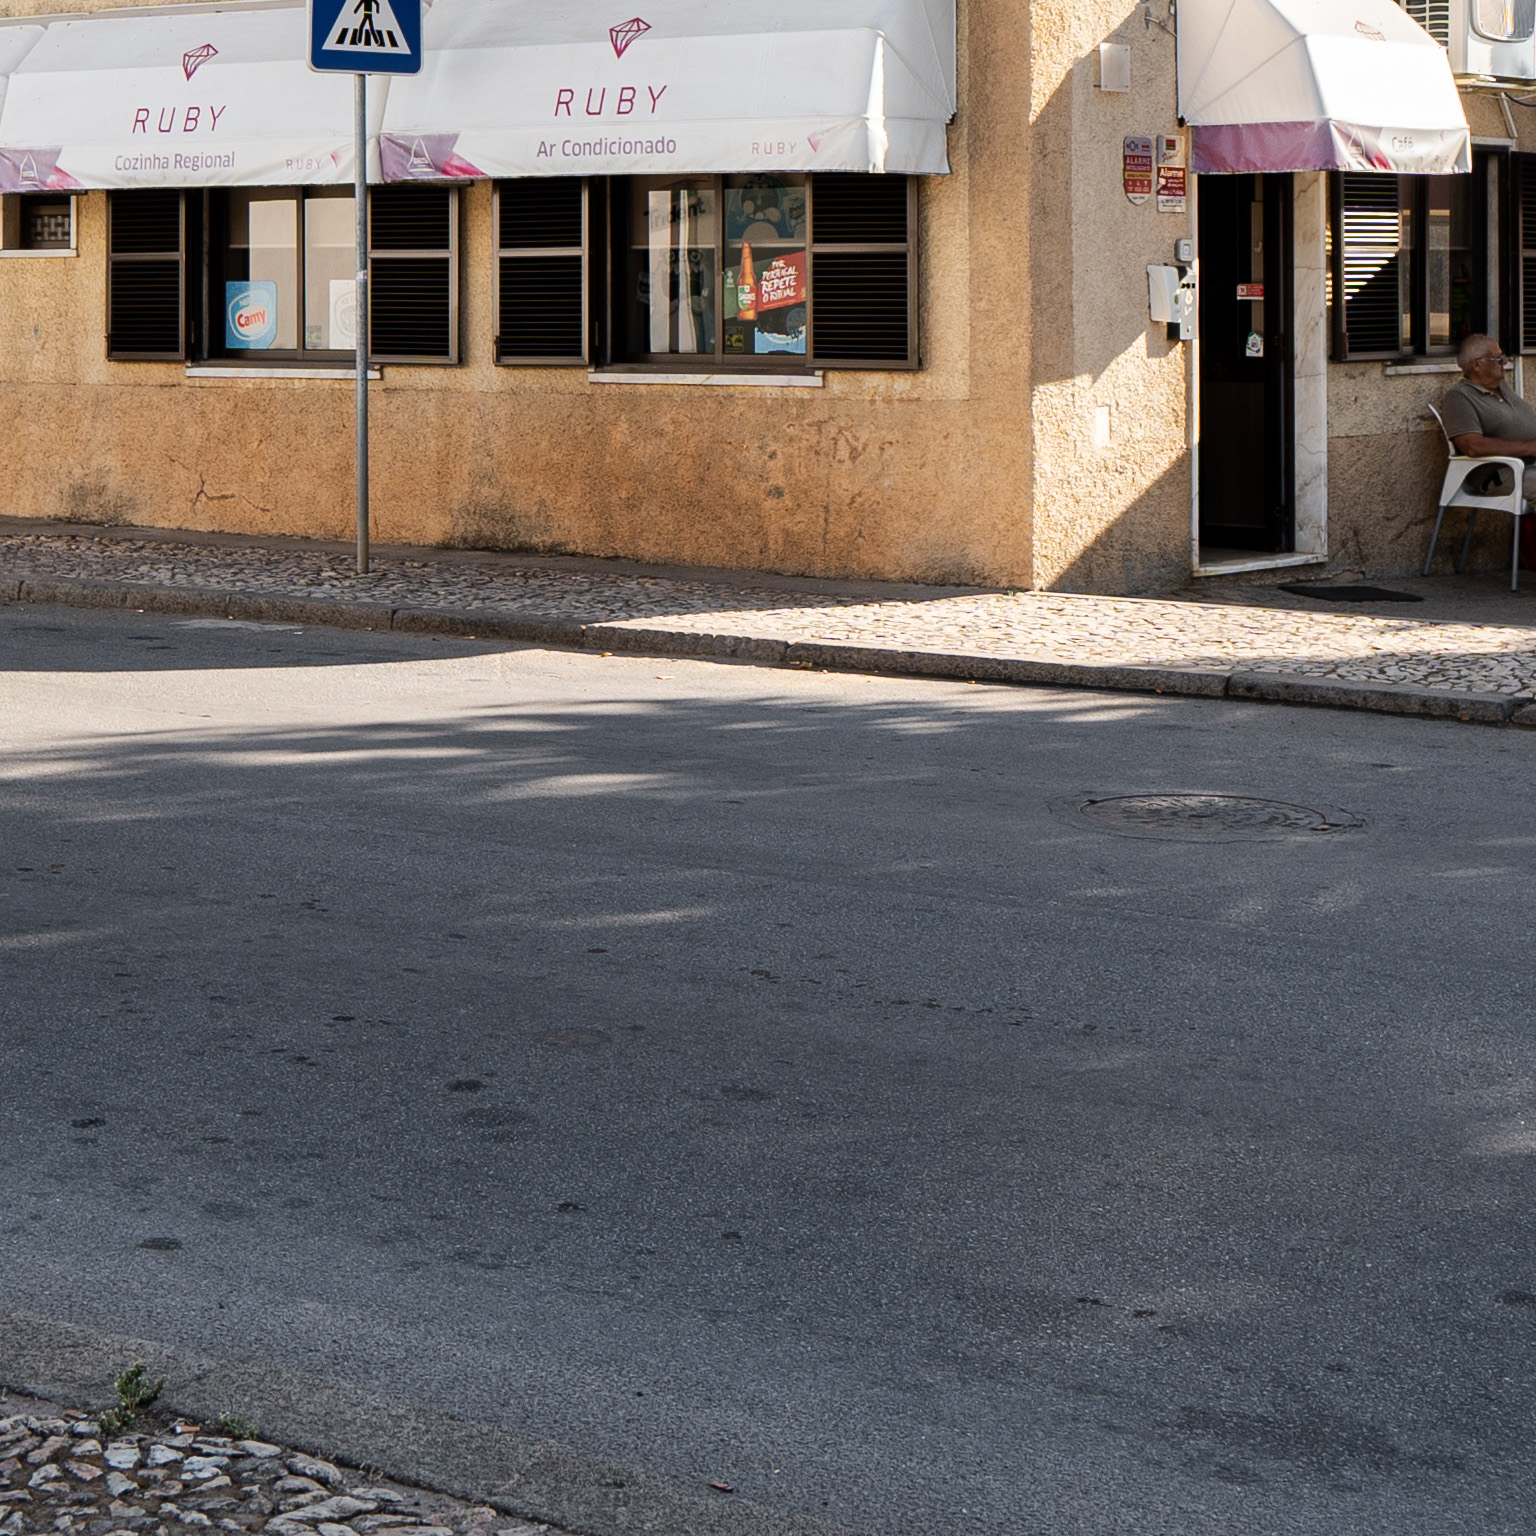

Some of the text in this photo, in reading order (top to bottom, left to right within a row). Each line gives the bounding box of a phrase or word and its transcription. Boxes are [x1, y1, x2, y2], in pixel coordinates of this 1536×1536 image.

[554, 85, 668, 116] RUBY
[132, 105, 227, 134] RUBY
[536, 136, 677, 158] Ar Condicionado
[751, 141, 798, 155] RUBY
[114, 151, 235, 171] Cozinha Regional
[285, 158, 322, 170] RUBY
[761, 275, 797, 295] REPETE
[237, 309, 266, 328] Camy
